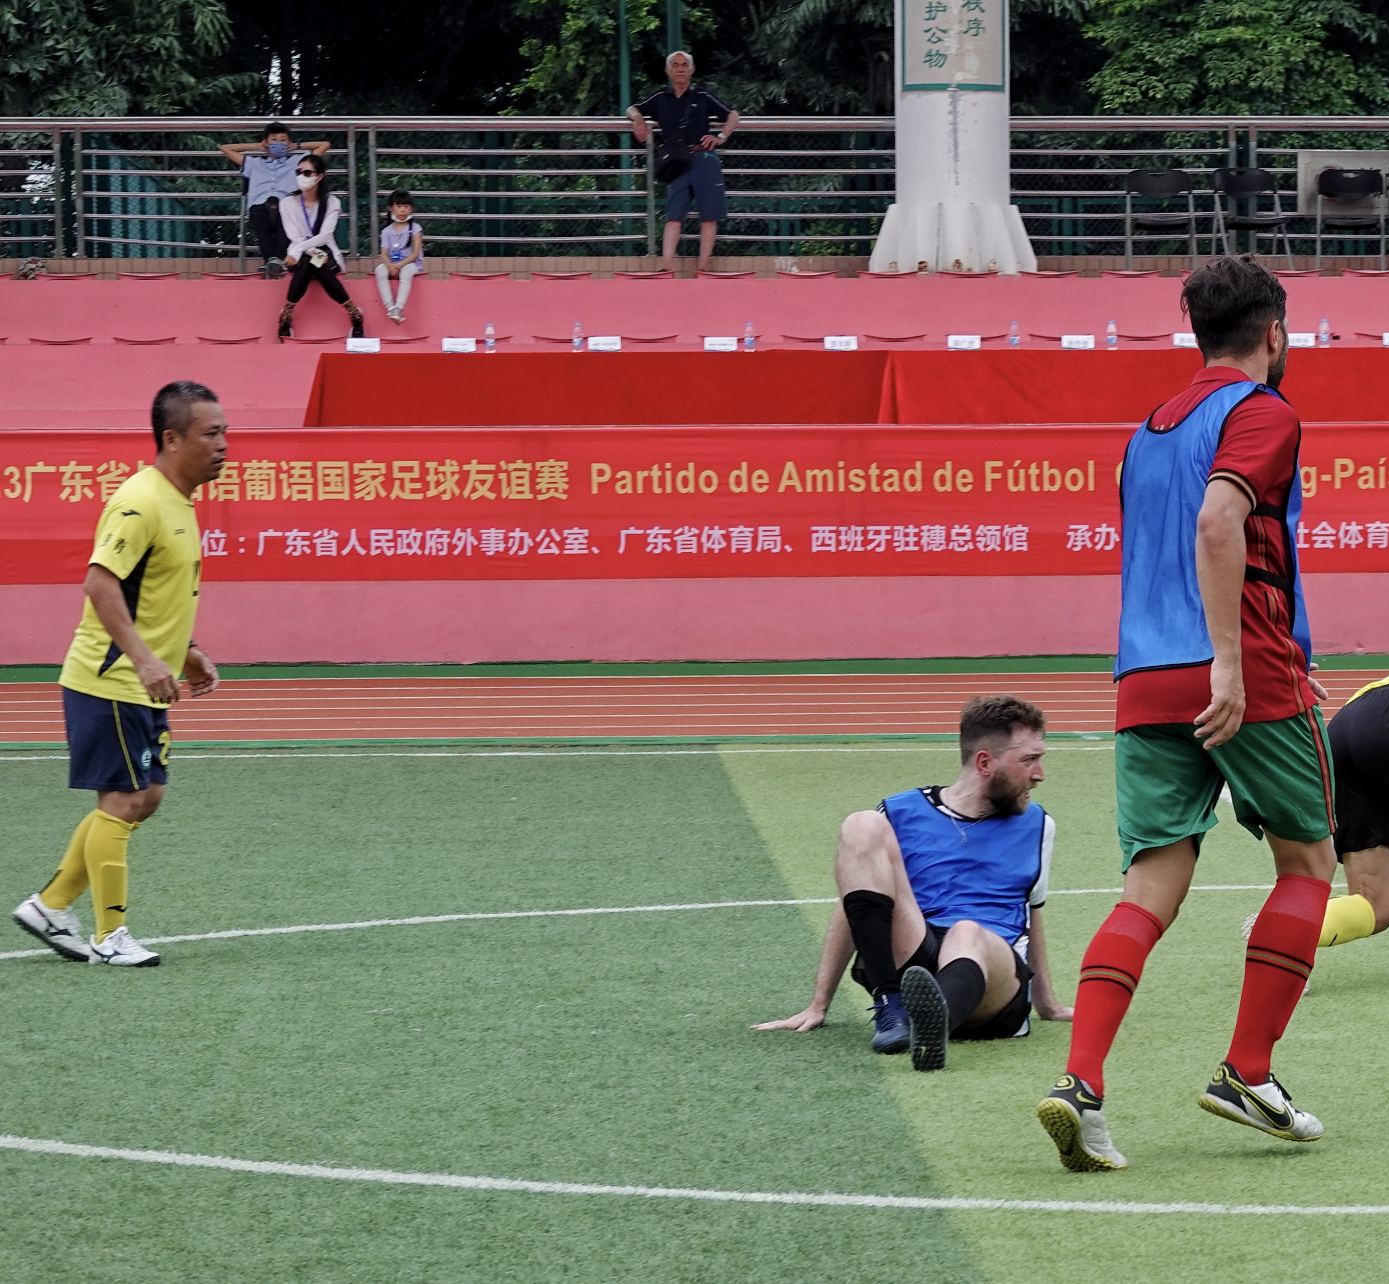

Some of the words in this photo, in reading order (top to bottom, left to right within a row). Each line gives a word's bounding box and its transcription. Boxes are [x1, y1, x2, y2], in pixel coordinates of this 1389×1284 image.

[922, 1, 948, 69] 护公物
[590, 462, 719, 495] Partido
[728, 461, 771, 494] de
[777, 460, 923, 493] Amistad
[933, 460, 975, 493] de
[984, 459, 1095, 492] Fútbol
